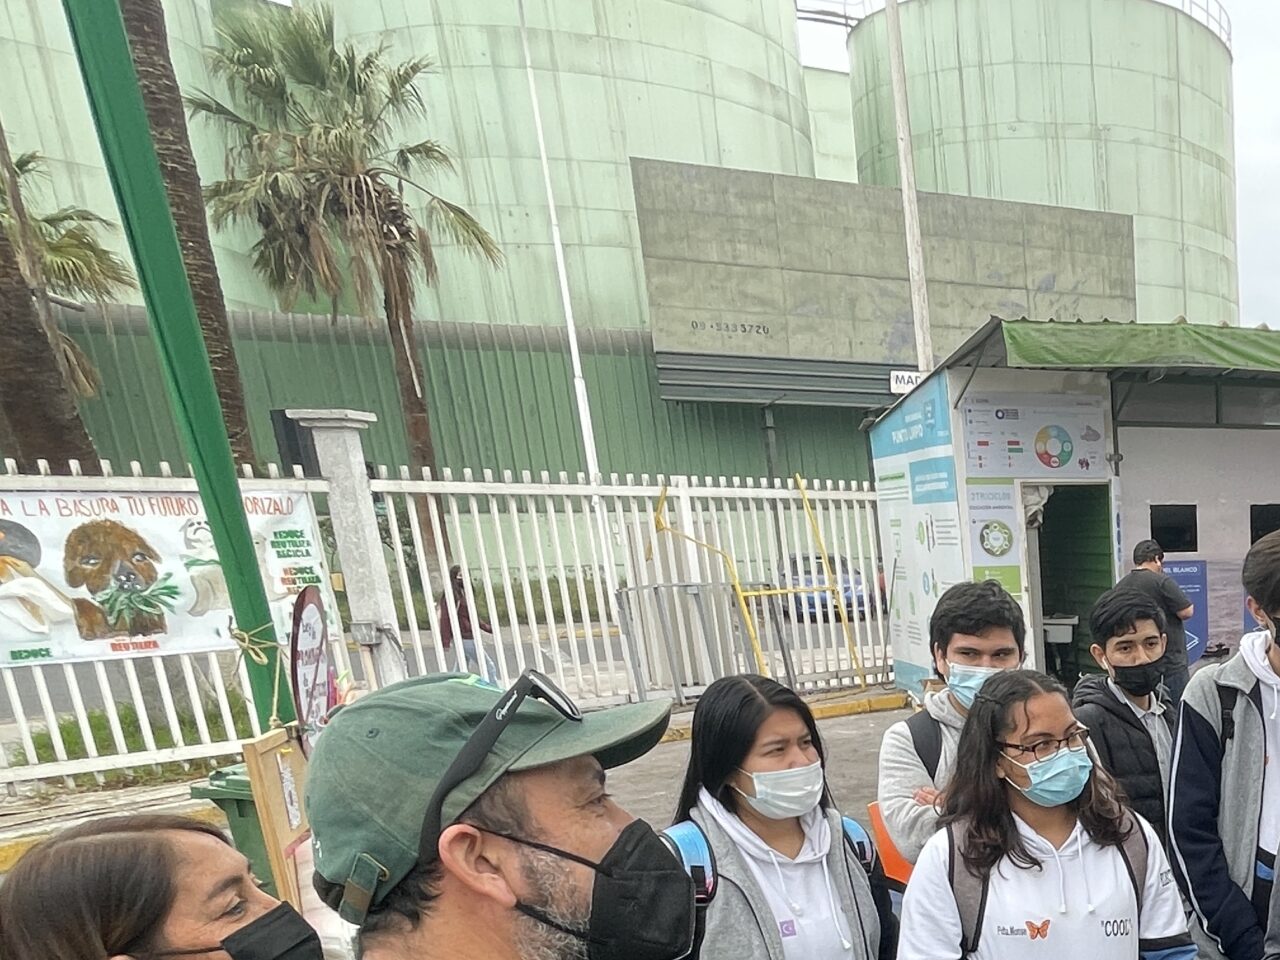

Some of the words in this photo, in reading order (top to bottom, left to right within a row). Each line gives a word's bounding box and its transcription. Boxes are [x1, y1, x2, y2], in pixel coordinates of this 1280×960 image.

[21, 499, 51, 516] LA
[55, 497, 120, 517] BASURA
[119, 496, 145, 516] TU
[148, 496, 199, 517] FUTURO
